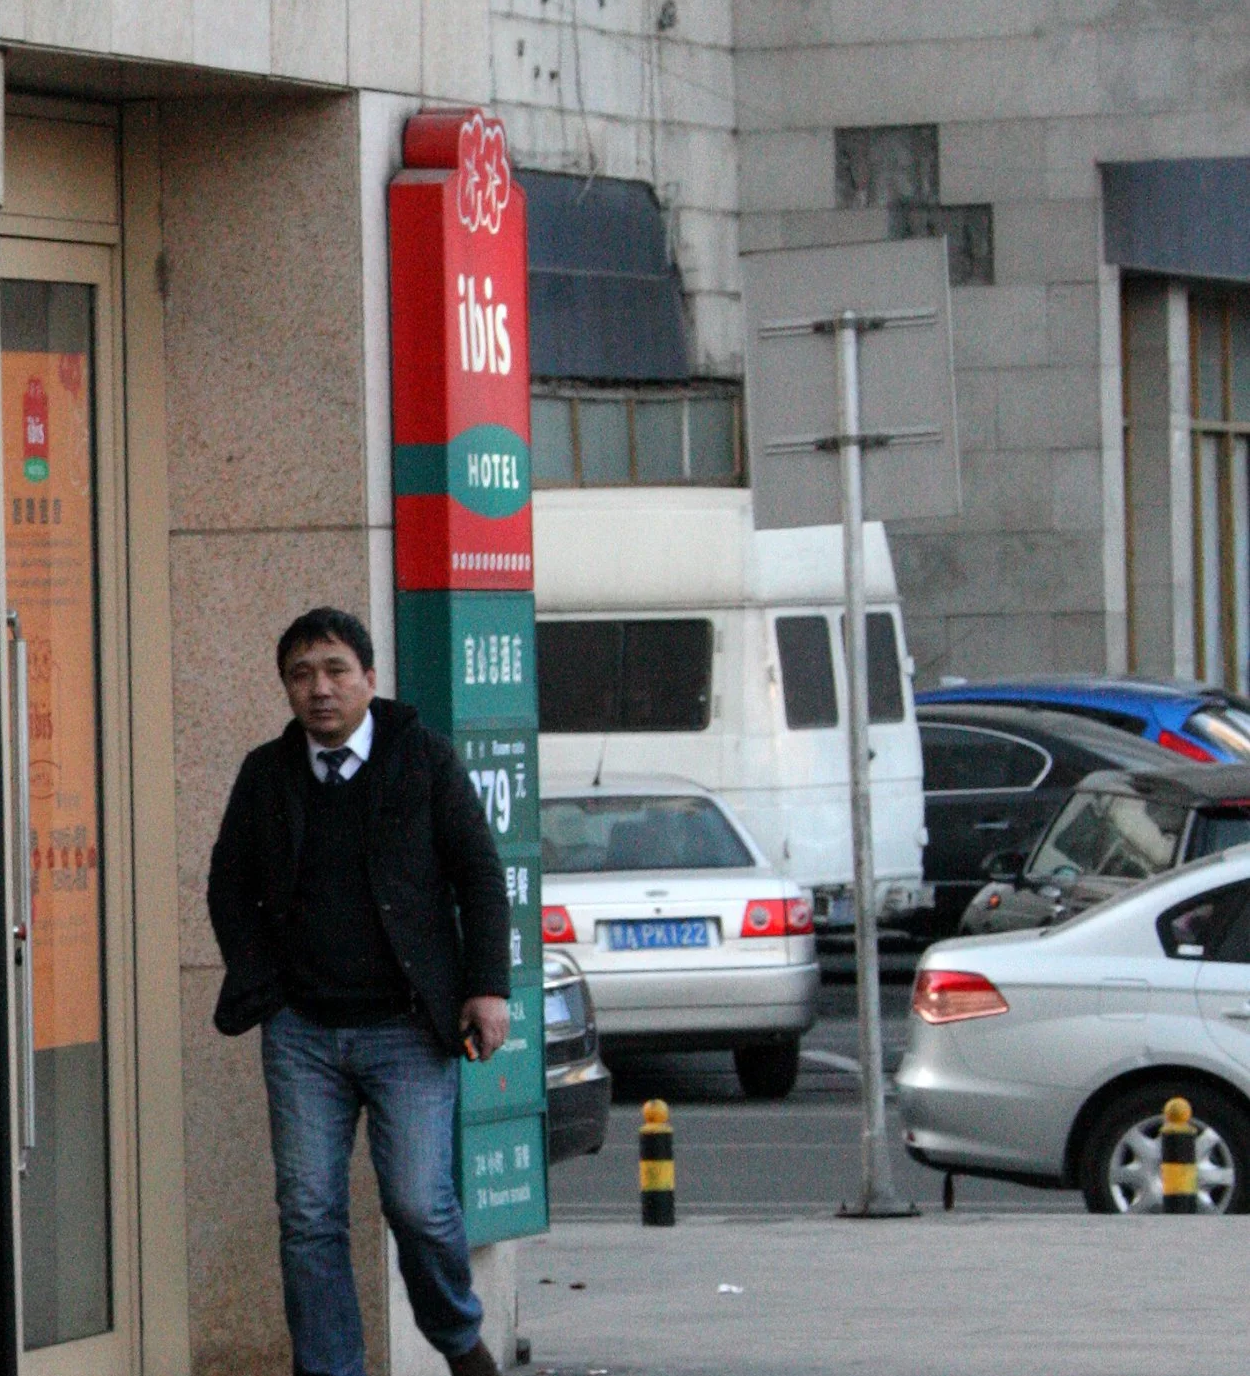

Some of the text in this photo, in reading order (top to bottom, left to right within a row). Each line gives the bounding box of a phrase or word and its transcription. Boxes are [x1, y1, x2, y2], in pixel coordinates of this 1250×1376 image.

[458, 274, 512, 376] ibis
[467, 453, 519, 490] HOTEL
[515, 762, 527, 799] 元
